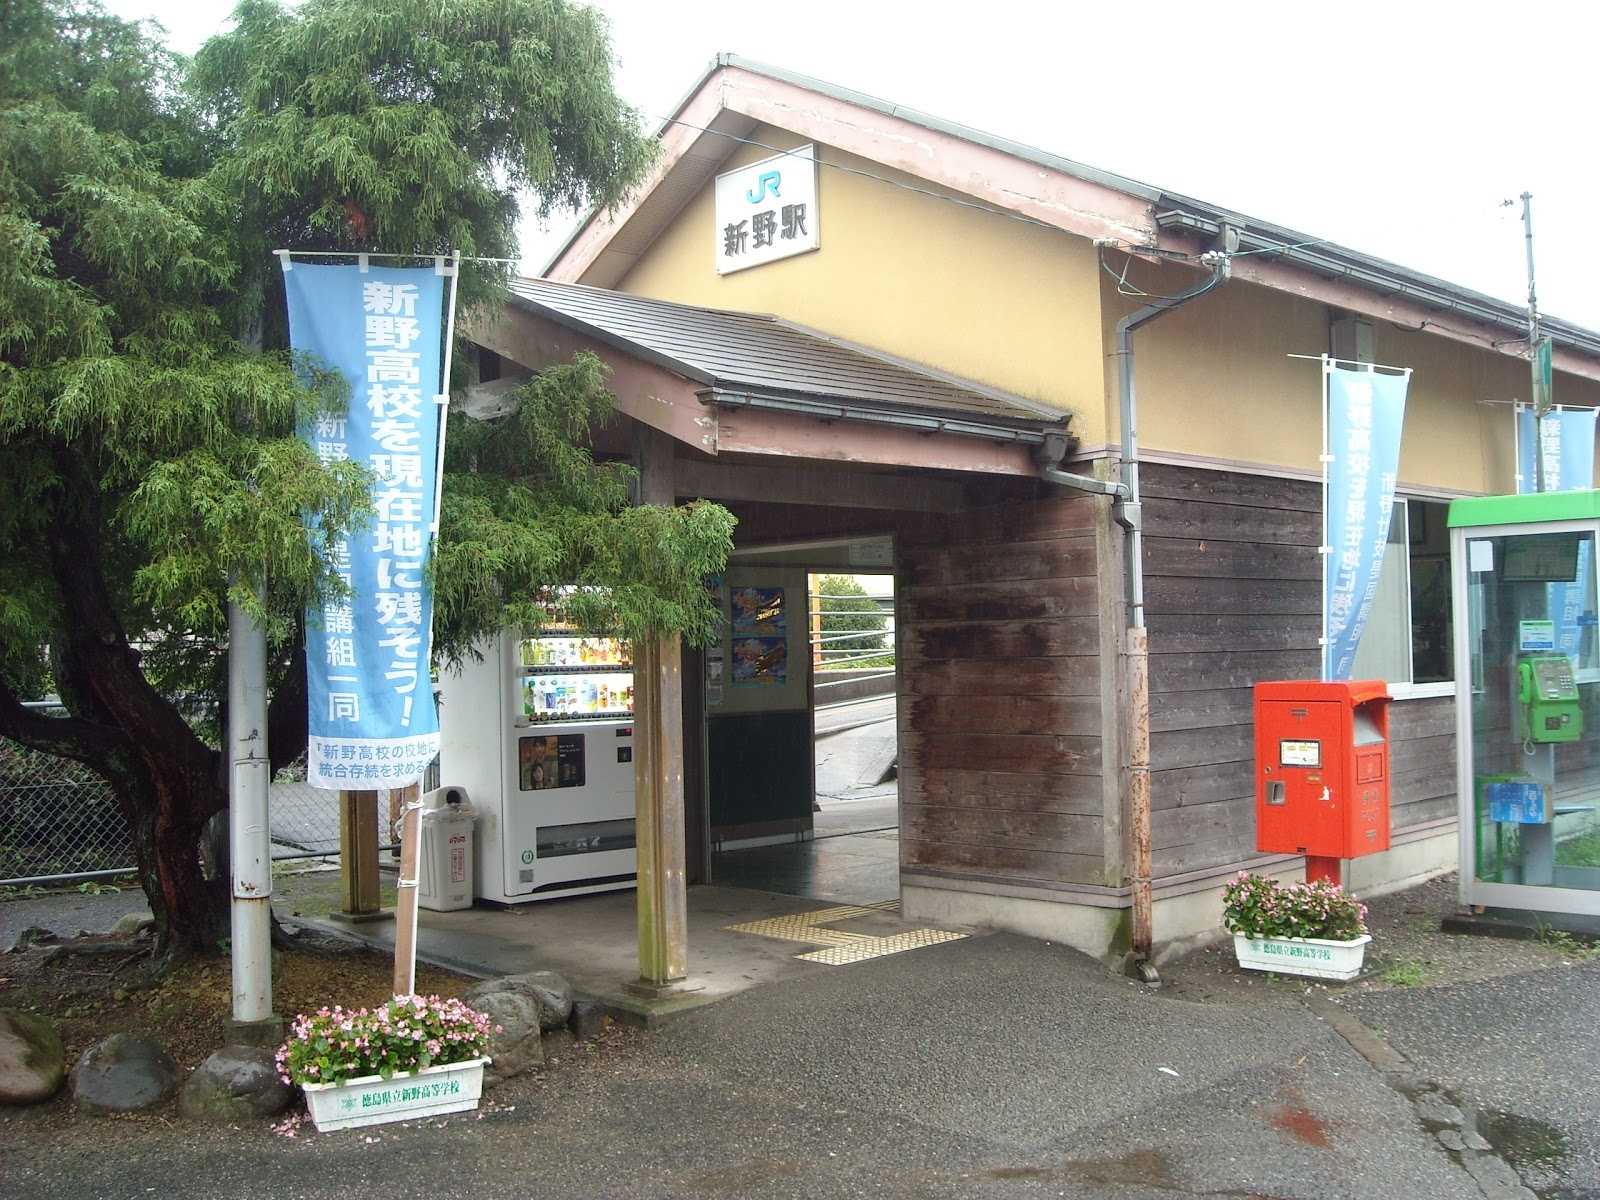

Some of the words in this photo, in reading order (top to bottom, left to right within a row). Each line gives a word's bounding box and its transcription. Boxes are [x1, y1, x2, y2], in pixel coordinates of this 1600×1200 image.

[746, 169, 782, 204] JR
[723, 203, 808, 257] 新野駅
[317, 412, 361, 722] 新野講組一同
[362, 1079, 461, 1108] 徳島県立新野高等学校
